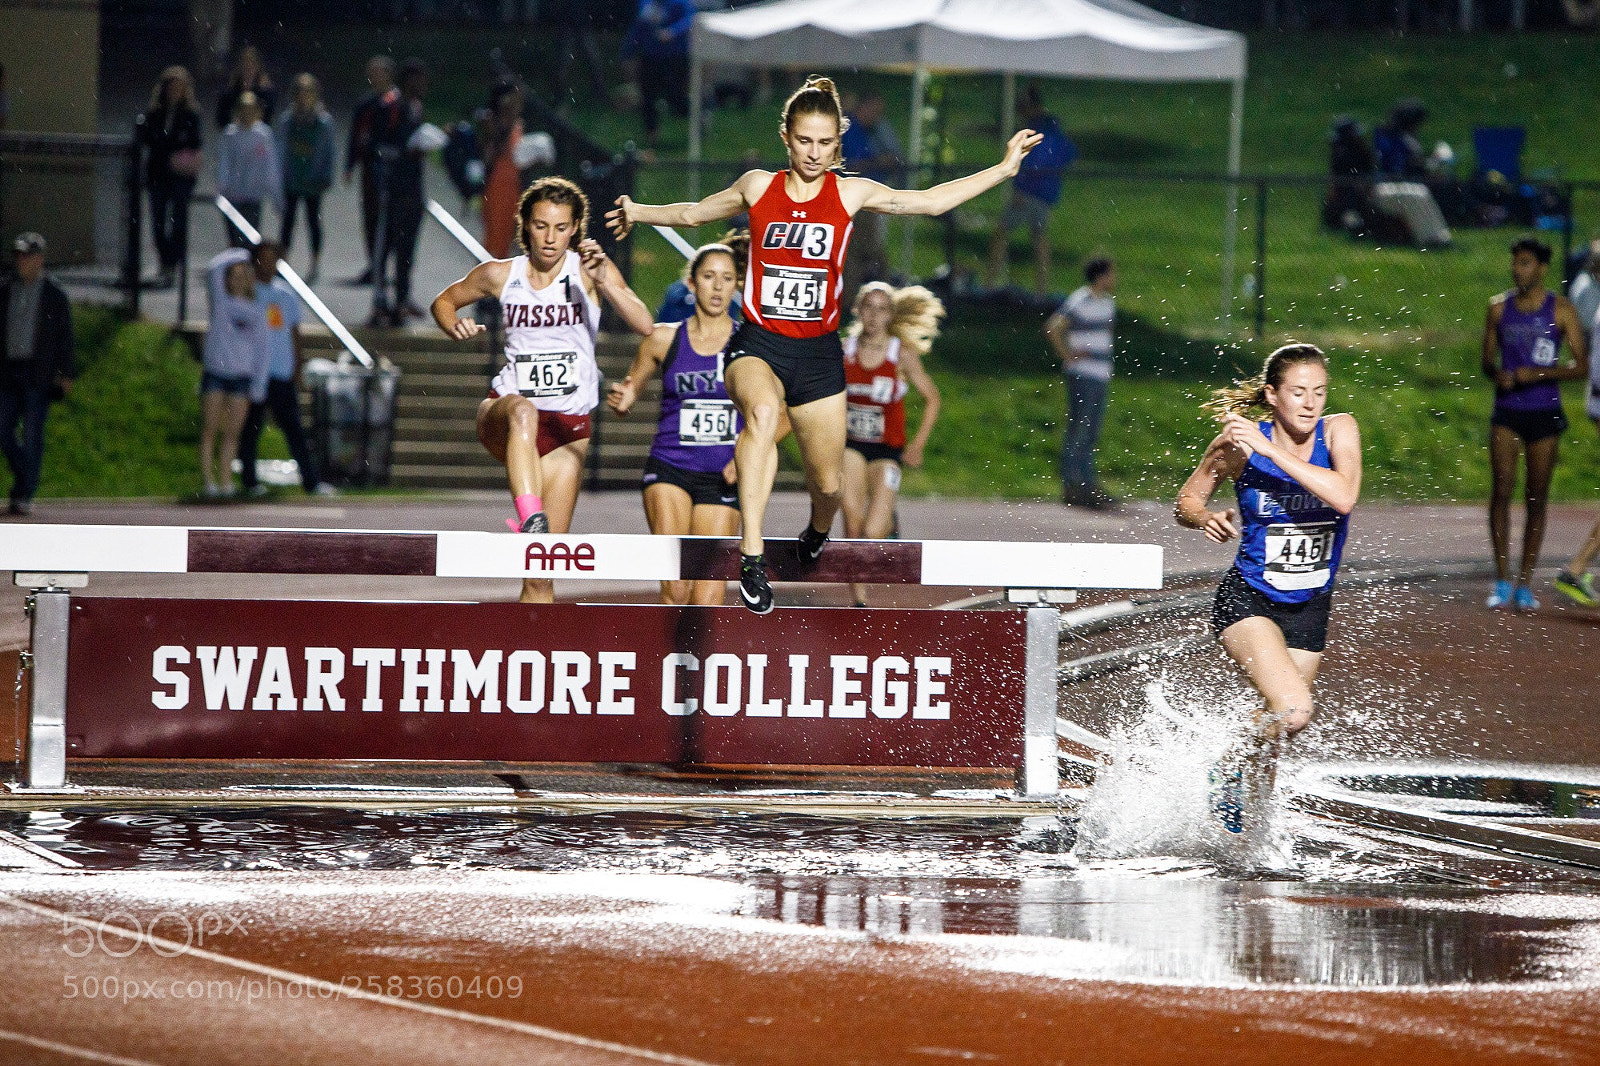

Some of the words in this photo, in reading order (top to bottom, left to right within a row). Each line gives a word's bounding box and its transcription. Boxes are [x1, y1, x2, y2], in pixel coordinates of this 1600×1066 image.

[807, 226, 827, 257] 3
[559, 274, 572, 303] 1
[773, 280, 815, 307] 445
[505, 303, 584, 328] VASSAR
[529, 363, 568, 387] 462
[691, 413, 727, 433] 456
[151, 645, 637, 716] SWARTHMORE
[661, 652, 953, 720] COLLEGE
